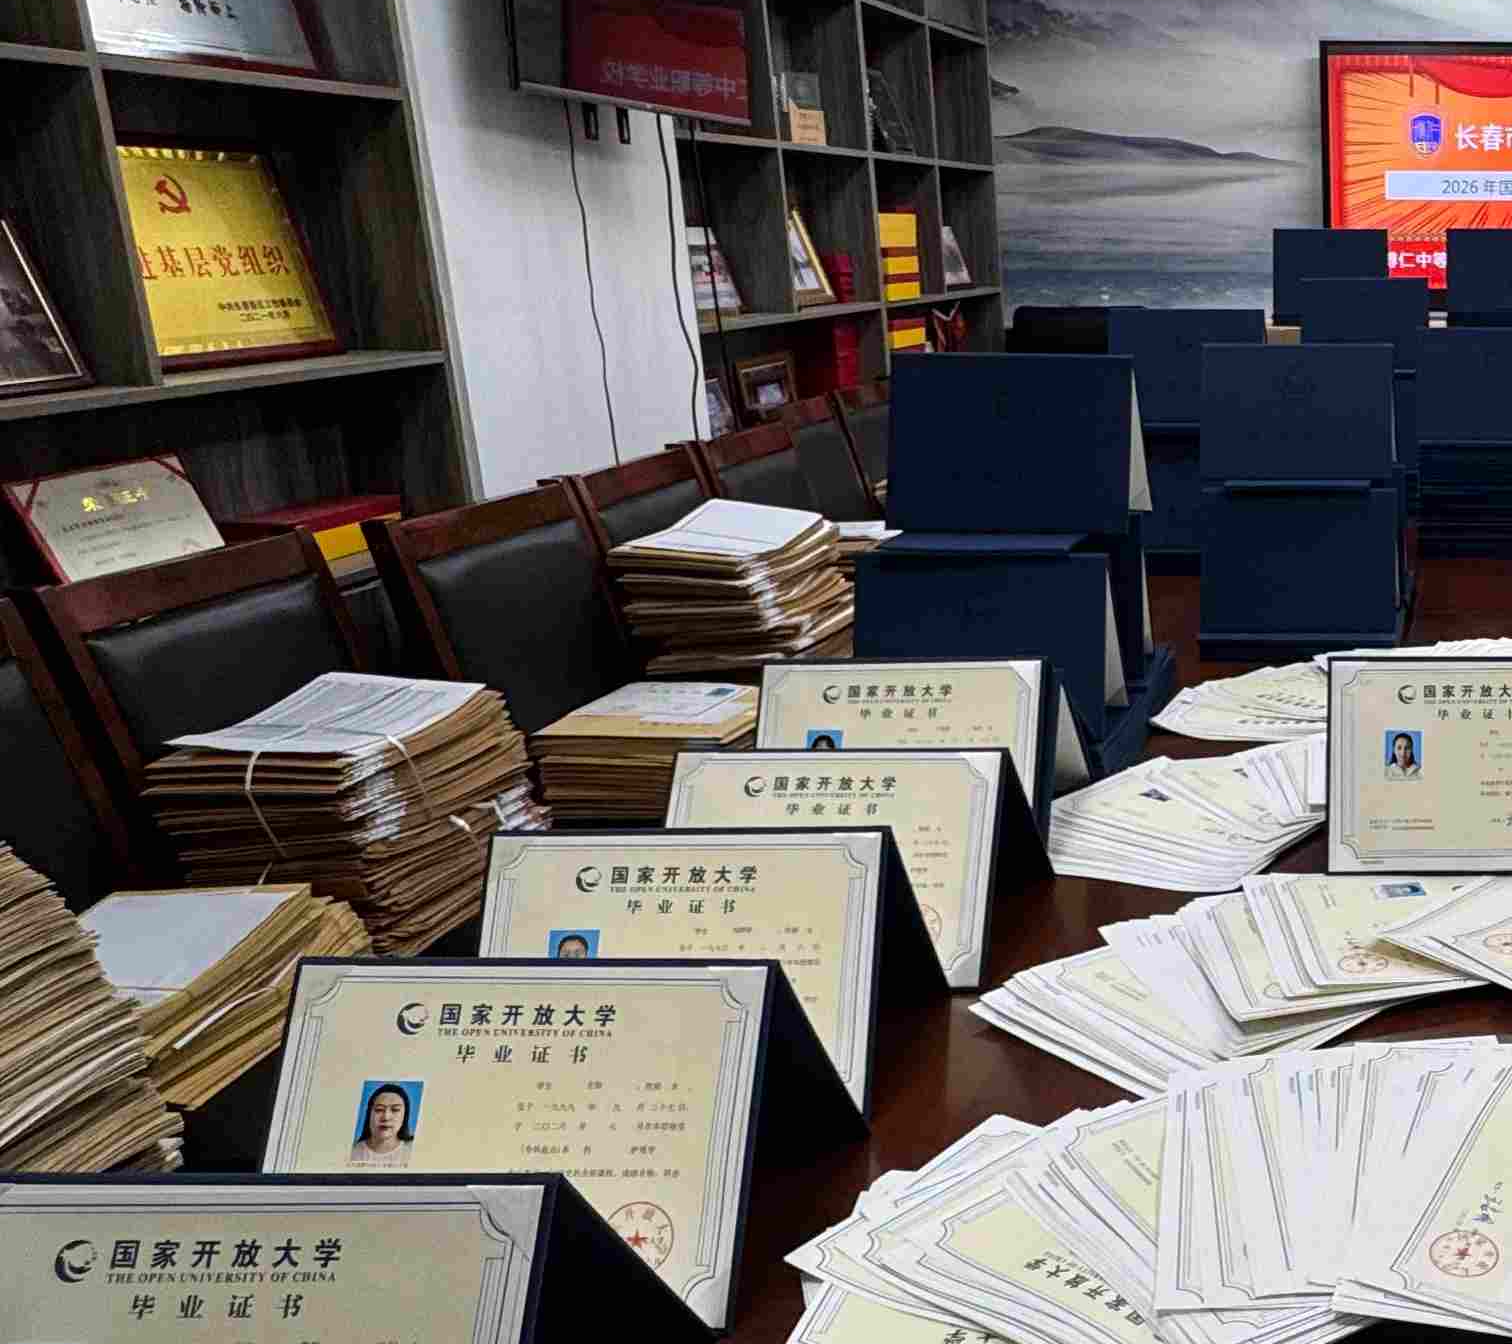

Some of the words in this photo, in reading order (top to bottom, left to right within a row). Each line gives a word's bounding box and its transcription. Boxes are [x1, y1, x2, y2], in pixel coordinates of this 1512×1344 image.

[1441, 180, 1479, 194] 2026
[847, 684, 953, 698] 国家开放大学
[859, 706, 940, 719] 毕业证书
[773, 776, 897, 793] 国家开放大学
[785, 803, 880, 817] 毕业证书
[609, 865, 759, 887] 国家开放大学
[626, 898, 738, 915] 毕业证书
[438, 1003, 617, 1028] 国家开放大学
[455, 1045, 589, 1064] 毕业证书
[108, 1237, 345, 1270] 国家开放大学
[105, 1271, 135, 1284] THE
[138, 1271, 177, 1284] OPEN
[180, 1271, 267, 1284] UNIVERSITY
[271, 1271, 289, 1284] OF
[292, 1271, 337, 1284] CHINA
[129, 1292, 306, 1321] 毕业证书
